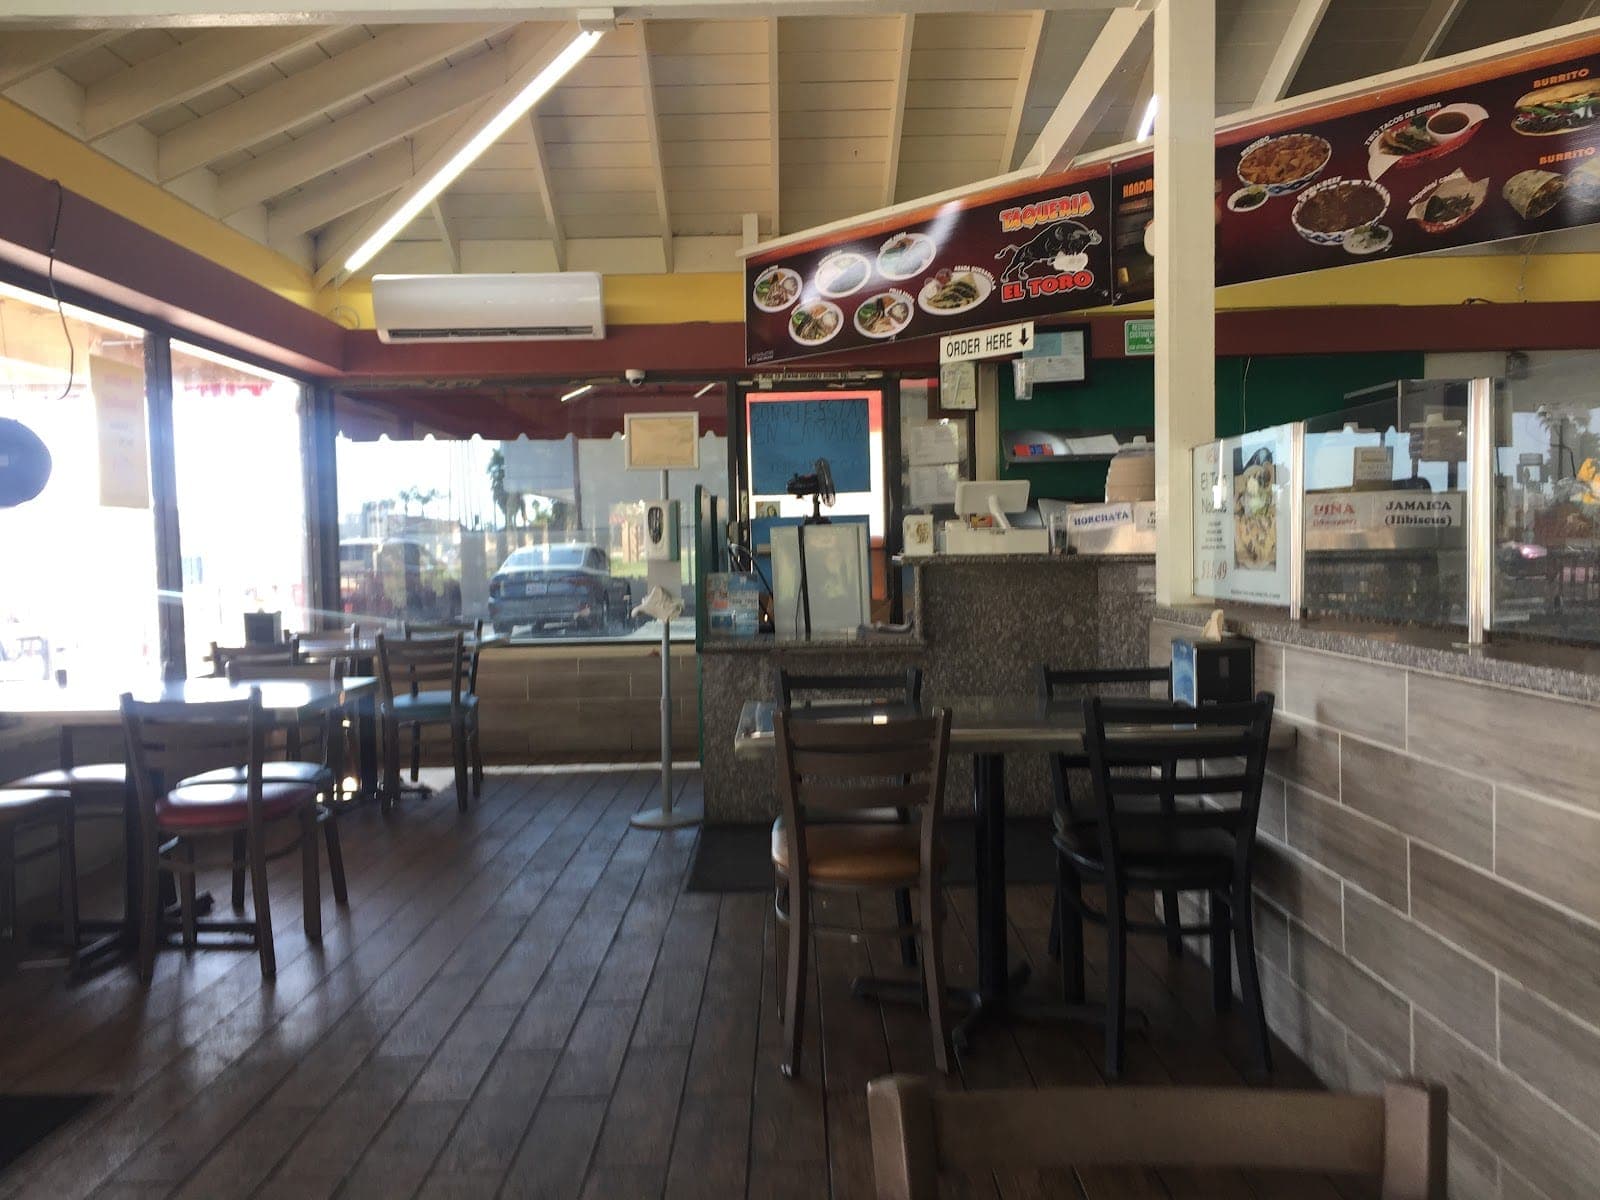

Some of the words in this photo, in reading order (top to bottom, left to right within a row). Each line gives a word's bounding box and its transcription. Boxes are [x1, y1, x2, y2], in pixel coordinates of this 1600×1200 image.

[1533, 68, 1590, 88] BURRITO
[1364, 130, 1379, 146] TWO
[1380, 114, 1404, 131] TACOS
[1405, 109, 1416, 119] DE
[1416, 102, 1442, 115] BIRRIA
[1539, 146, 1596, 165] BURRITO
[1001, 192, 1093, 231] TAQUERIA
[1002, 281, 1025, 302] EL
[1028, 270, 1093, 298] TORO
[946, 338, 980, 357] ORDER
[985, 331, 1012, 350] HERE
[1386, 500, 1452, 511] JAMAICA
[1074, 509, 1129, 526] HORCHATA
[1385, 514, 1452, 526] (Hibiscus)
